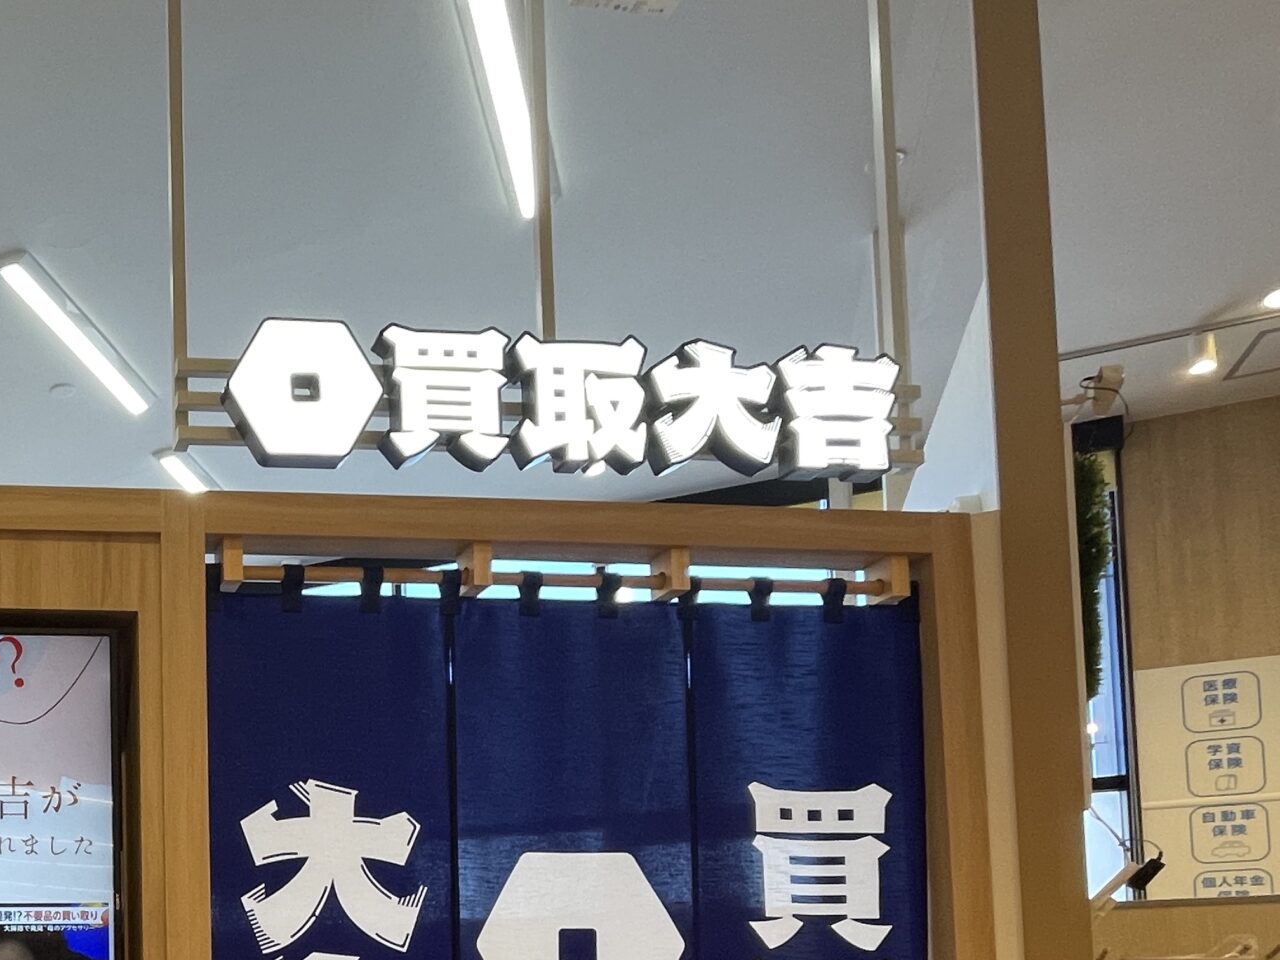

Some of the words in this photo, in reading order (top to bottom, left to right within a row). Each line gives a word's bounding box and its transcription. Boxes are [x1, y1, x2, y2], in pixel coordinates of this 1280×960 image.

[372, 323, 900, 481] 買取大吉
[1203, 678, 1237, 692] 医療
[1203, 692, 1239, 706] 保険
[1207, 742, 1242, 756] 学資
[1207, 757, 1243, 771] 保険
[1202, 809, 1257, 823] 自動車
[1212, 824, 1248, 837] 保険
[1201, 875, 1265, 888] 個人年金
